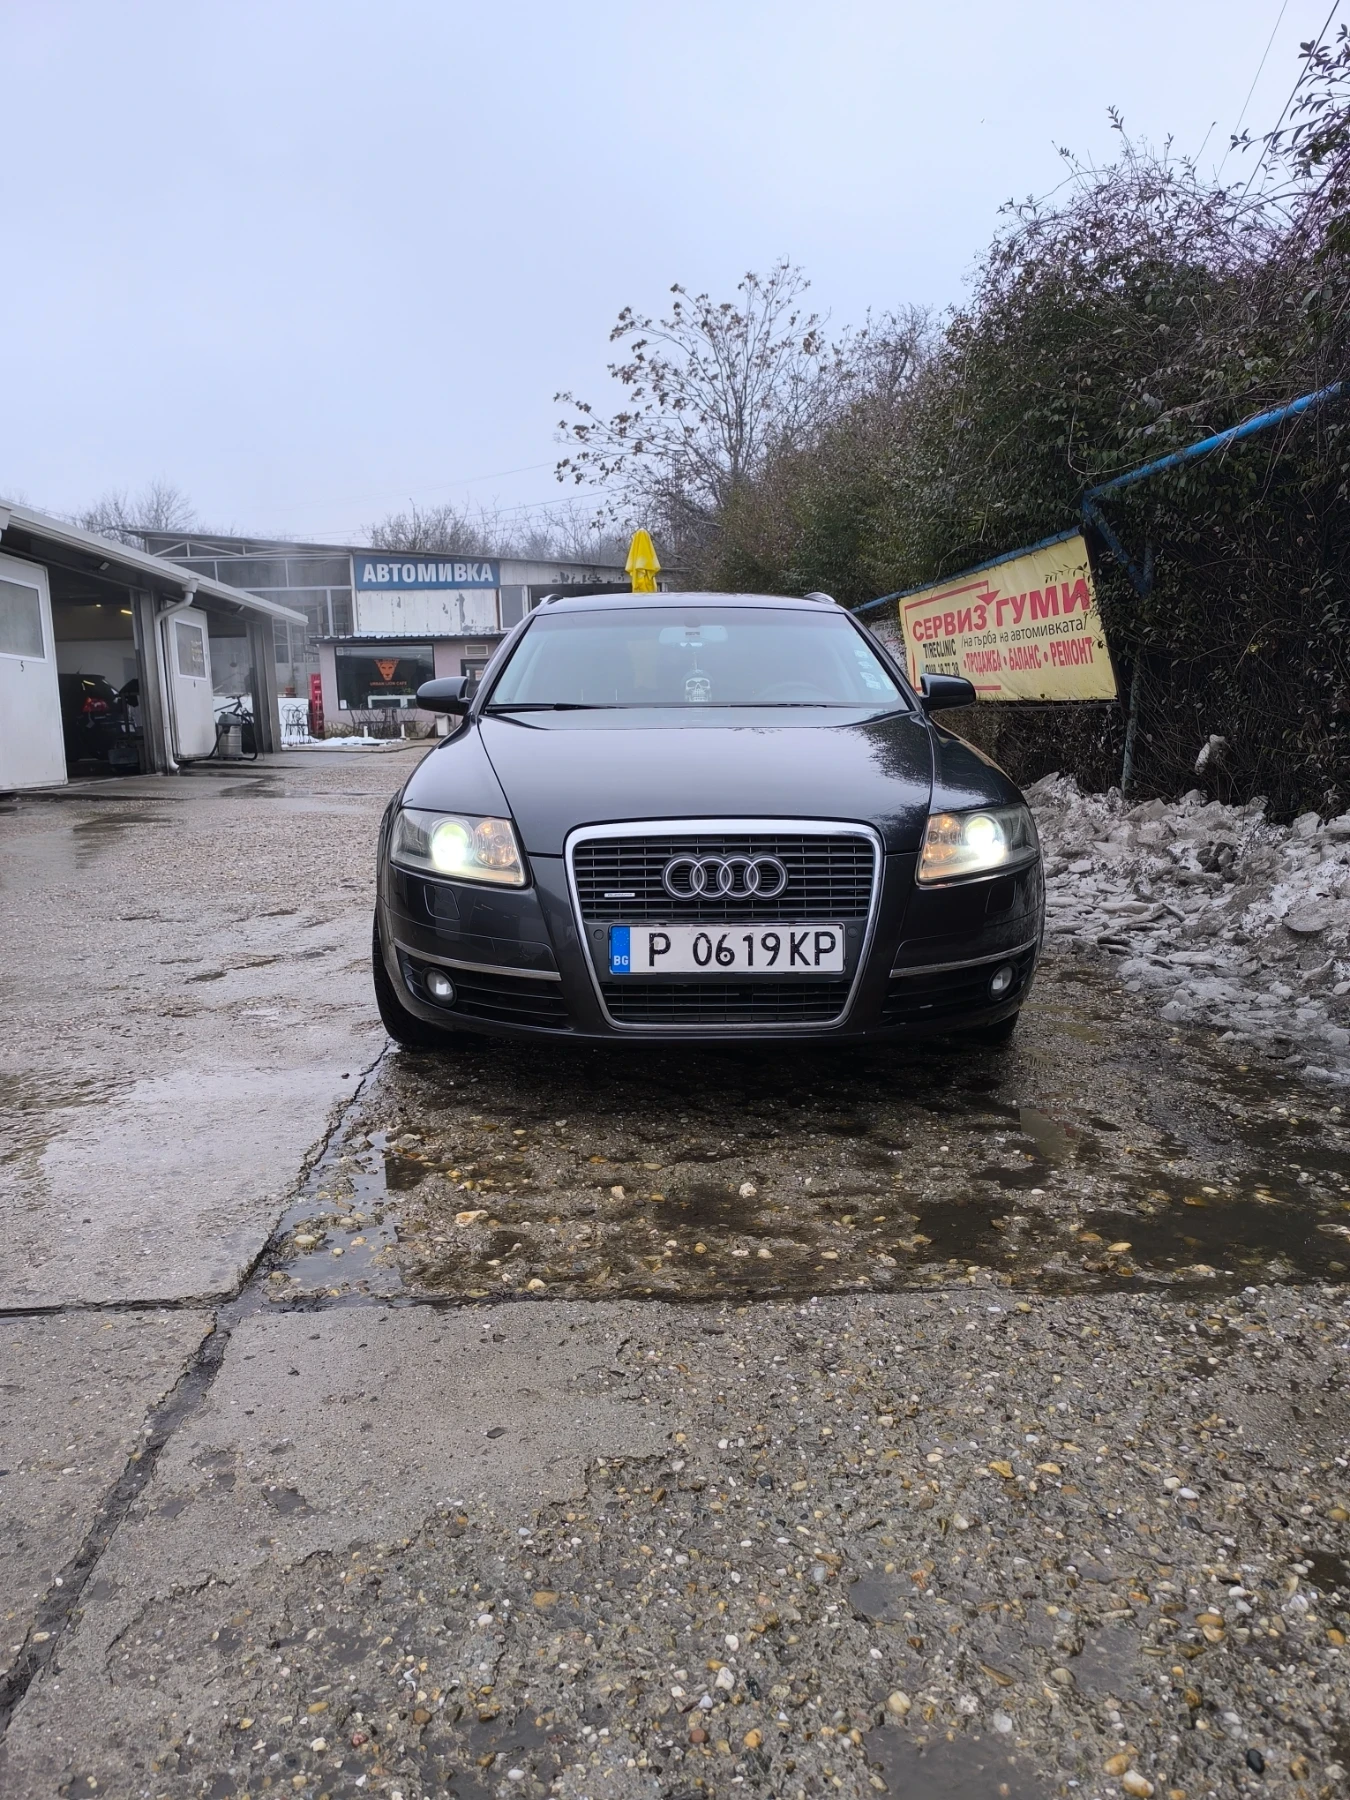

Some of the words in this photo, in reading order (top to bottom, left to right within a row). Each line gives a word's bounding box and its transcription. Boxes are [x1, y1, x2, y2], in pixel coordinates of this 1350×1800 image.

[362, 563, 494, 583] АВТОМИВКА
[912, 604, 987, 642] СЕРВИЗ
[995, 578, 1091, 628] ГУМИ
[923, 639, 957, 659] TIRECLINIC
[966, 649, 1003, 677] ПРОДАЖБА
[1008, 643, 1042, 671] БАЛАНС
[1049, 636, 1094, 667] РЕМОНТ
[613, 955, 629, 966] BG
[648, 932, 671, 966] P
